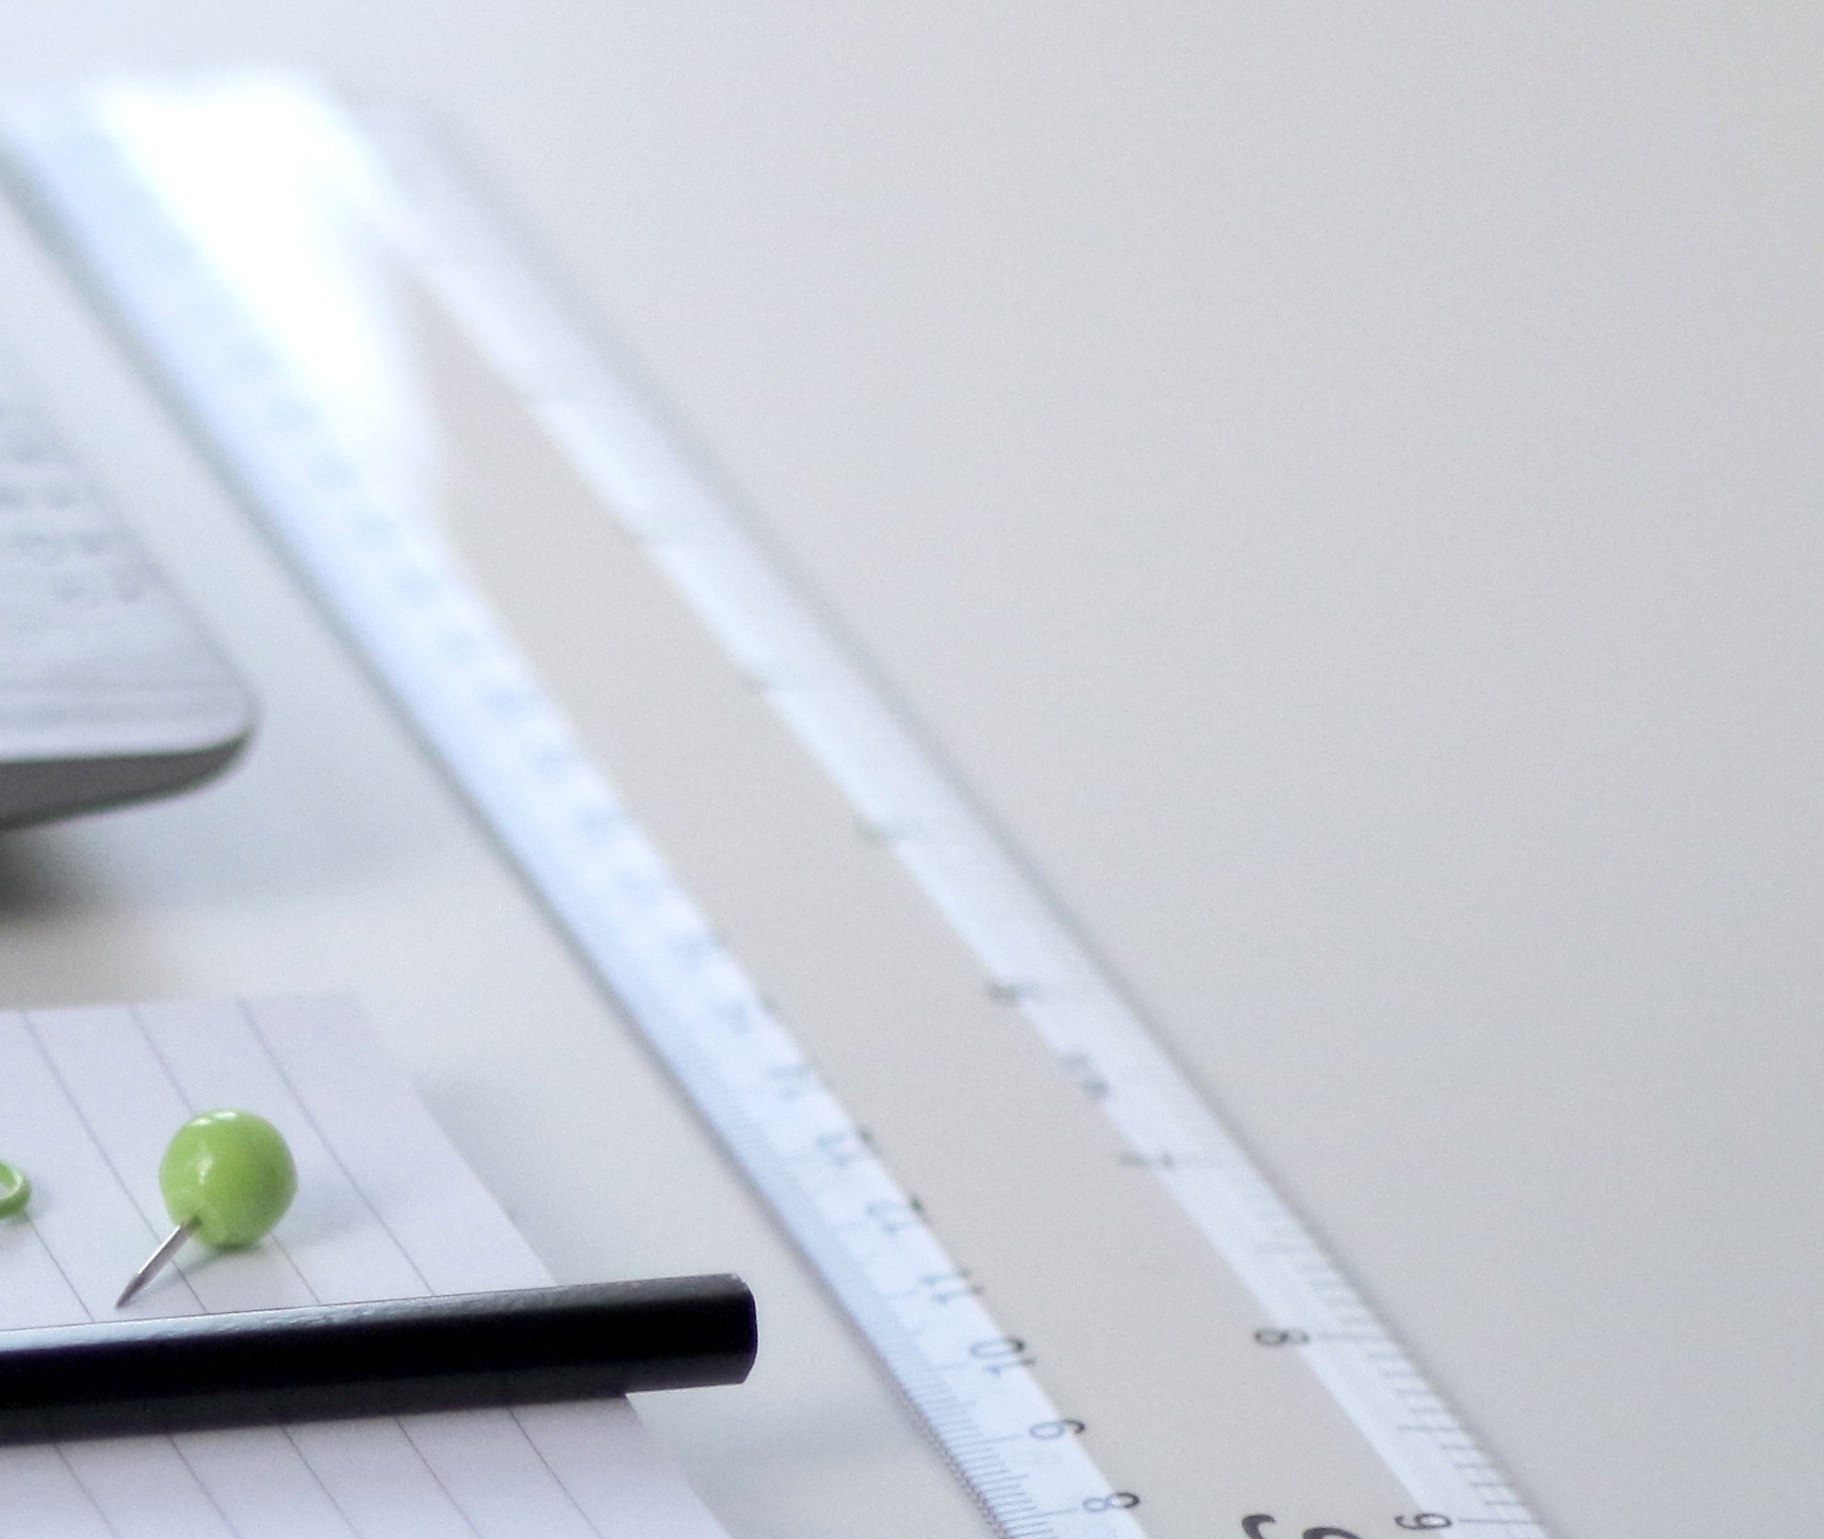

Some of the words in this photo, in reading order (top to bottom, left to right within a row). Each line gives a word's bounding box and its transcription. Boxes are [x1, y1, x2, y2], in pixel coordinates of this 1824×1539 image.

[968, 1336, 1036, 1377] 10
[1027, 1418, 1086, 1440] 9
[1081, 1491, 1141, 1514] 8
[1254, 1327, 1310, 1347] 8
[1393, 1512, 1452, 1533] 9
